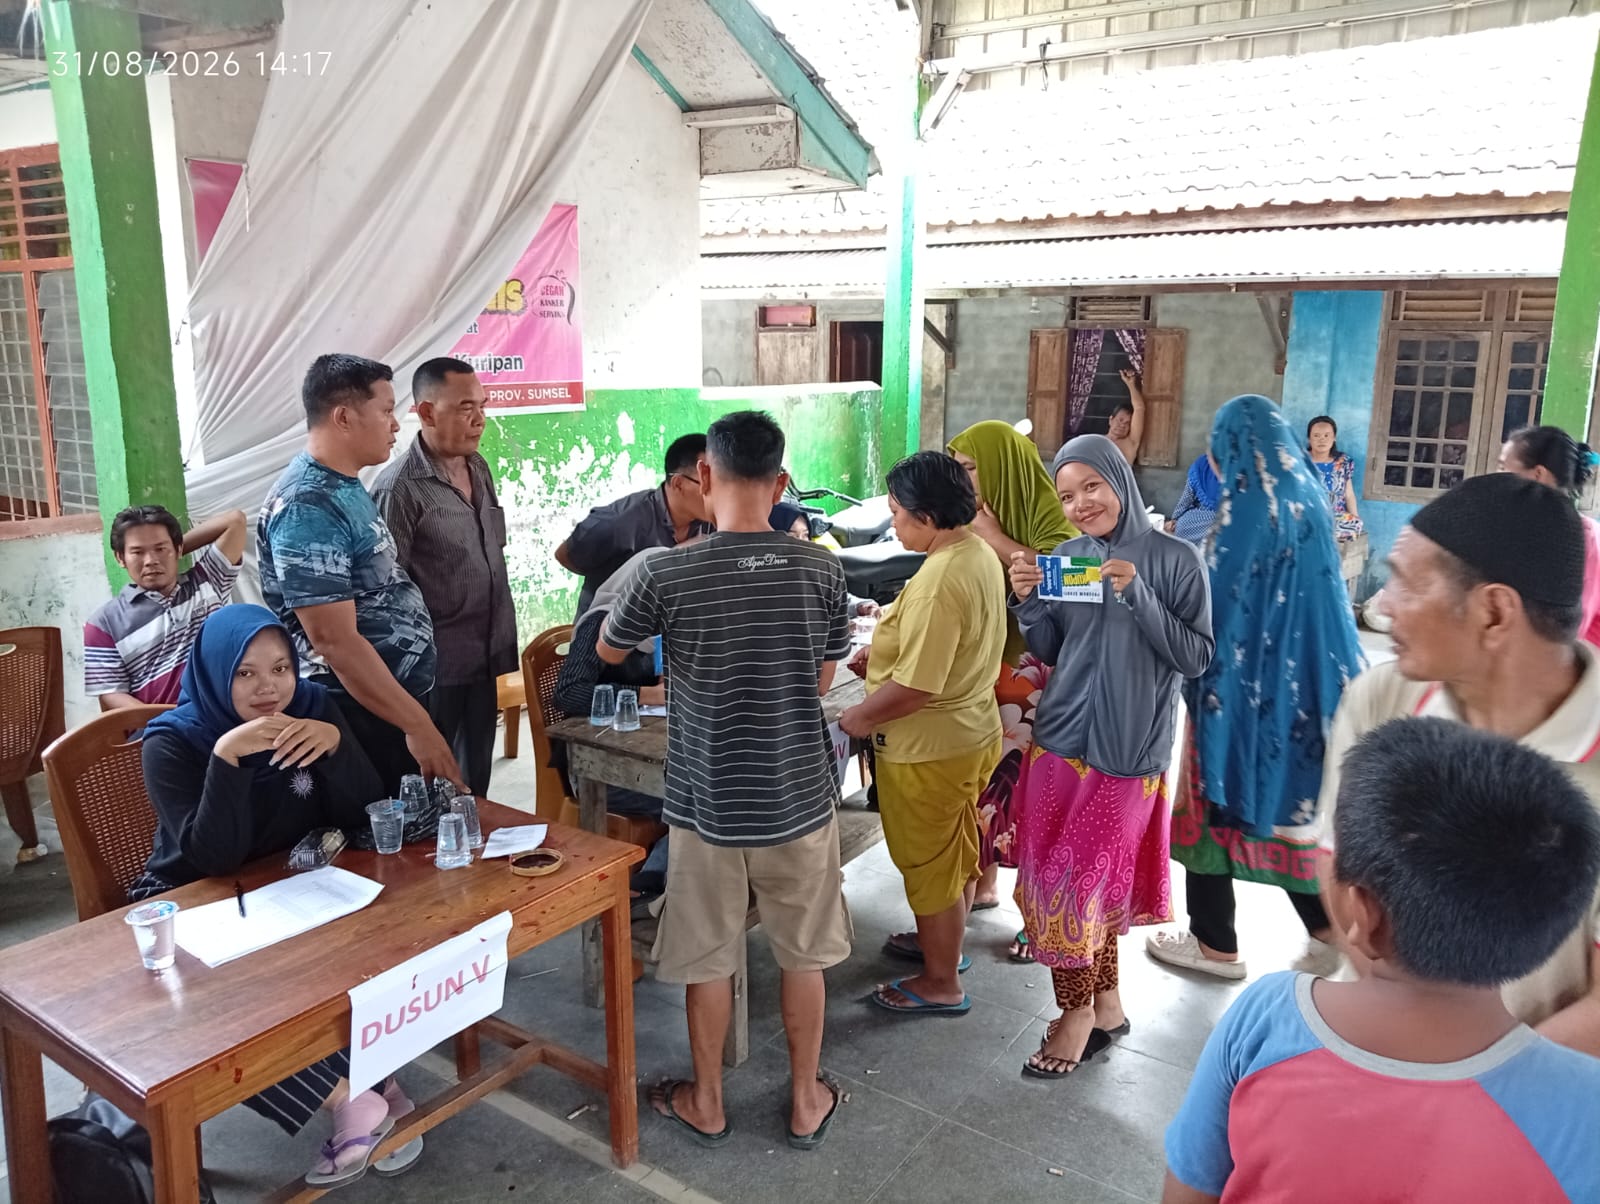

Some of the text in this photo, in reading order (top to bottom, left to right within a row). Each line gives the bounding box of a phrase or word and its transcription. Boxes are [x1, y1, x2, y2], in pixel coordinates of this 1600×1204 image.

[489, 387, 571, 401] PROV. SUMSEL
[361, 954, 490, 1050] DUSUN V
